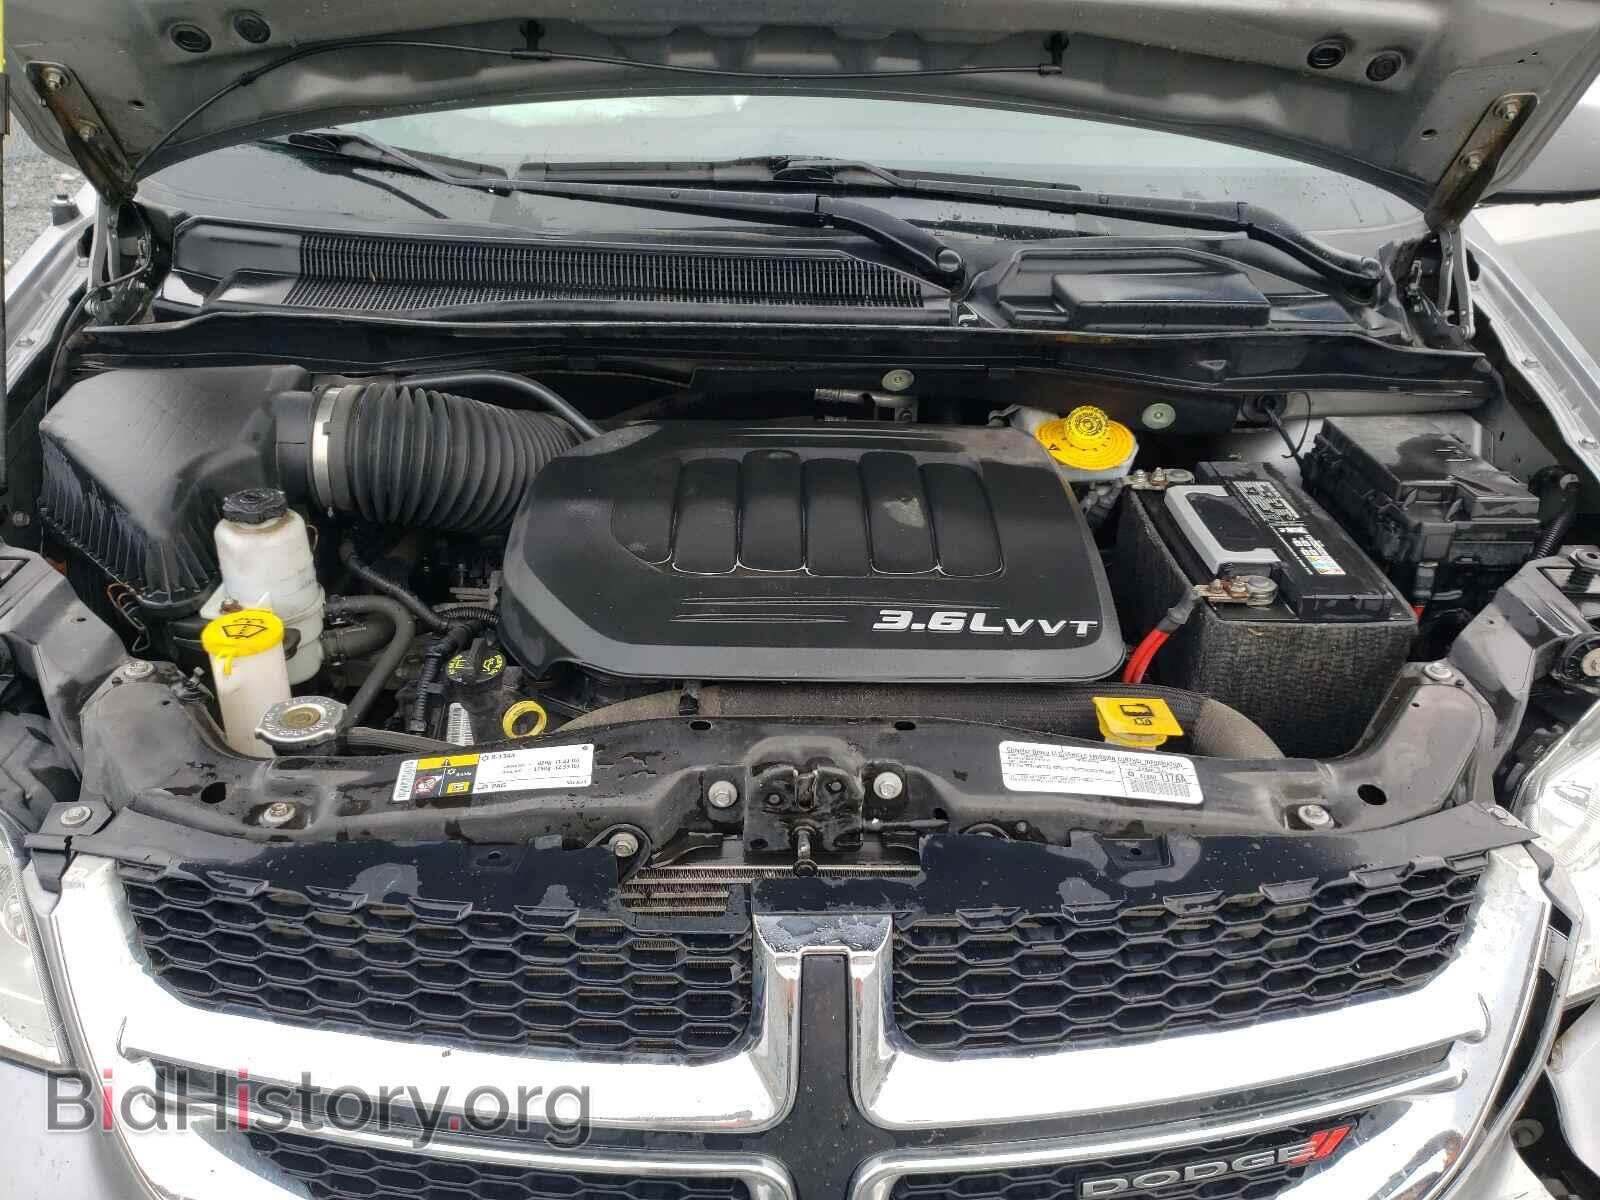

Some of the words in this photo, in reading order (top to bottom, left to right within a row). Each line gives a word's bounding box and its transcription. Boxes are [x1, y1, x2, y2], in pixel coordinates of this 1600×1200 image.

[872, 609, 1004, 633] 3.6L
[1006, 618, 1099, 637] VVT
[1082, 1141, 1318, 1198] DODGE
